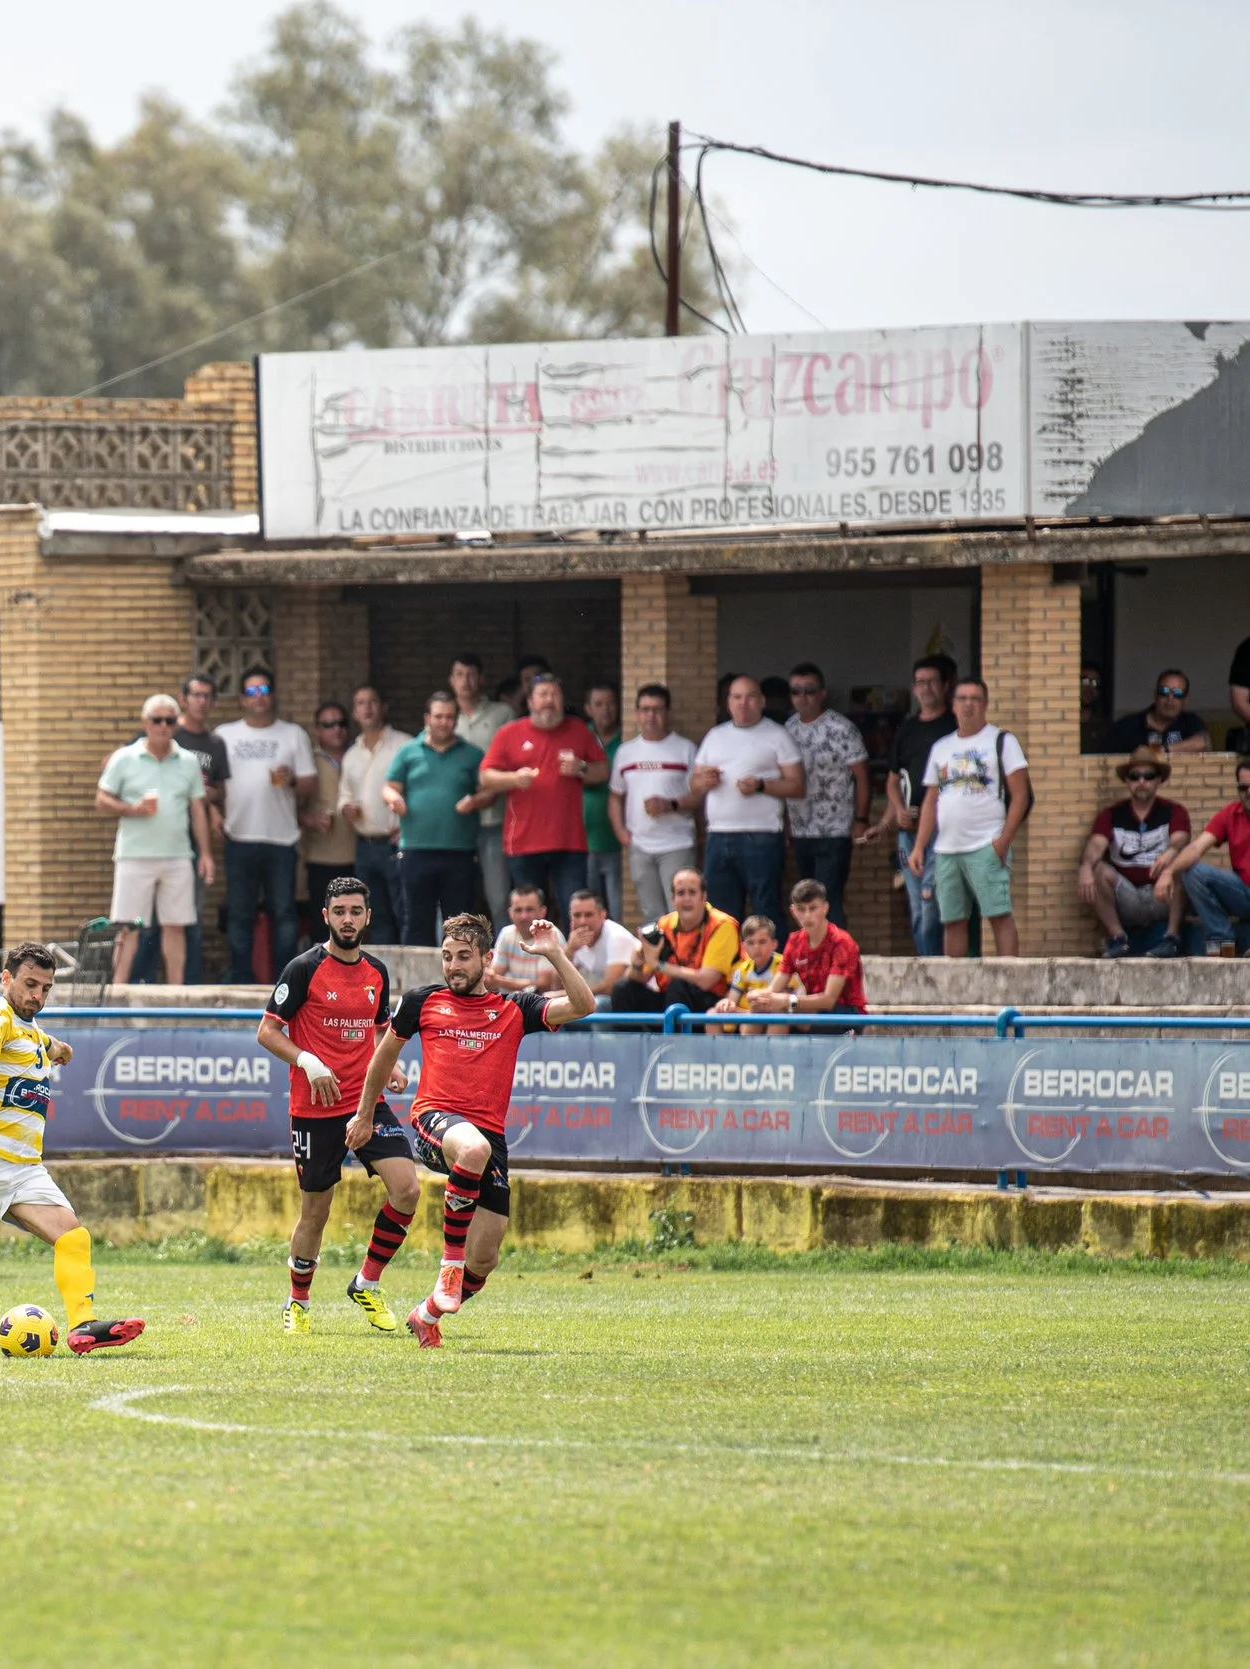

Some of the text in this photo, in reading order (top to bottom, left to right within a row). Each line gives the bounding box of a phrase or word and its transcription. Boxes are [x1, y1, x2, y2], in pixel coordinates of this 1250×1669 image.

[679, 343, 994, 429] Cruzcampo
[826, 442, 1004, 477] 955 761 098
[338, 510, 363, 531] LA
[369, 504, 480, 530] CONFIANZA
[490, 504, 515, 527] DE
[520, 500, 627, 526] TRABAJAR
[639, 499, 683, 524] CON
[879, 489, 950, 515] DESDE
[961, 488, 1006, 512] 1935
[323, 1017, 338, 1027] LAS
[115, 1055, 271, 1084] BERROCAR
[513, 1061, 616, 1090] RROCAR
[656, 1063, 795, 1091] BERROCAR
[834, 1065, 978, 1095] BERROCAR
[1024, 1068, 1174, 1098] BERROCAR
[120, 1098, 267, 1122] RENT A CAR
[545, 1105, 562, 1128] A
[564, 1105, 611, 1129] CAR
[659, 1108, 790, 1132] RENT A CAR
[838, 1111, 973, 1136] RENT A CAR
[1027, 1114, 1169, 1140] RENT A CAR
[292, 1130, 311, 1160] 24
